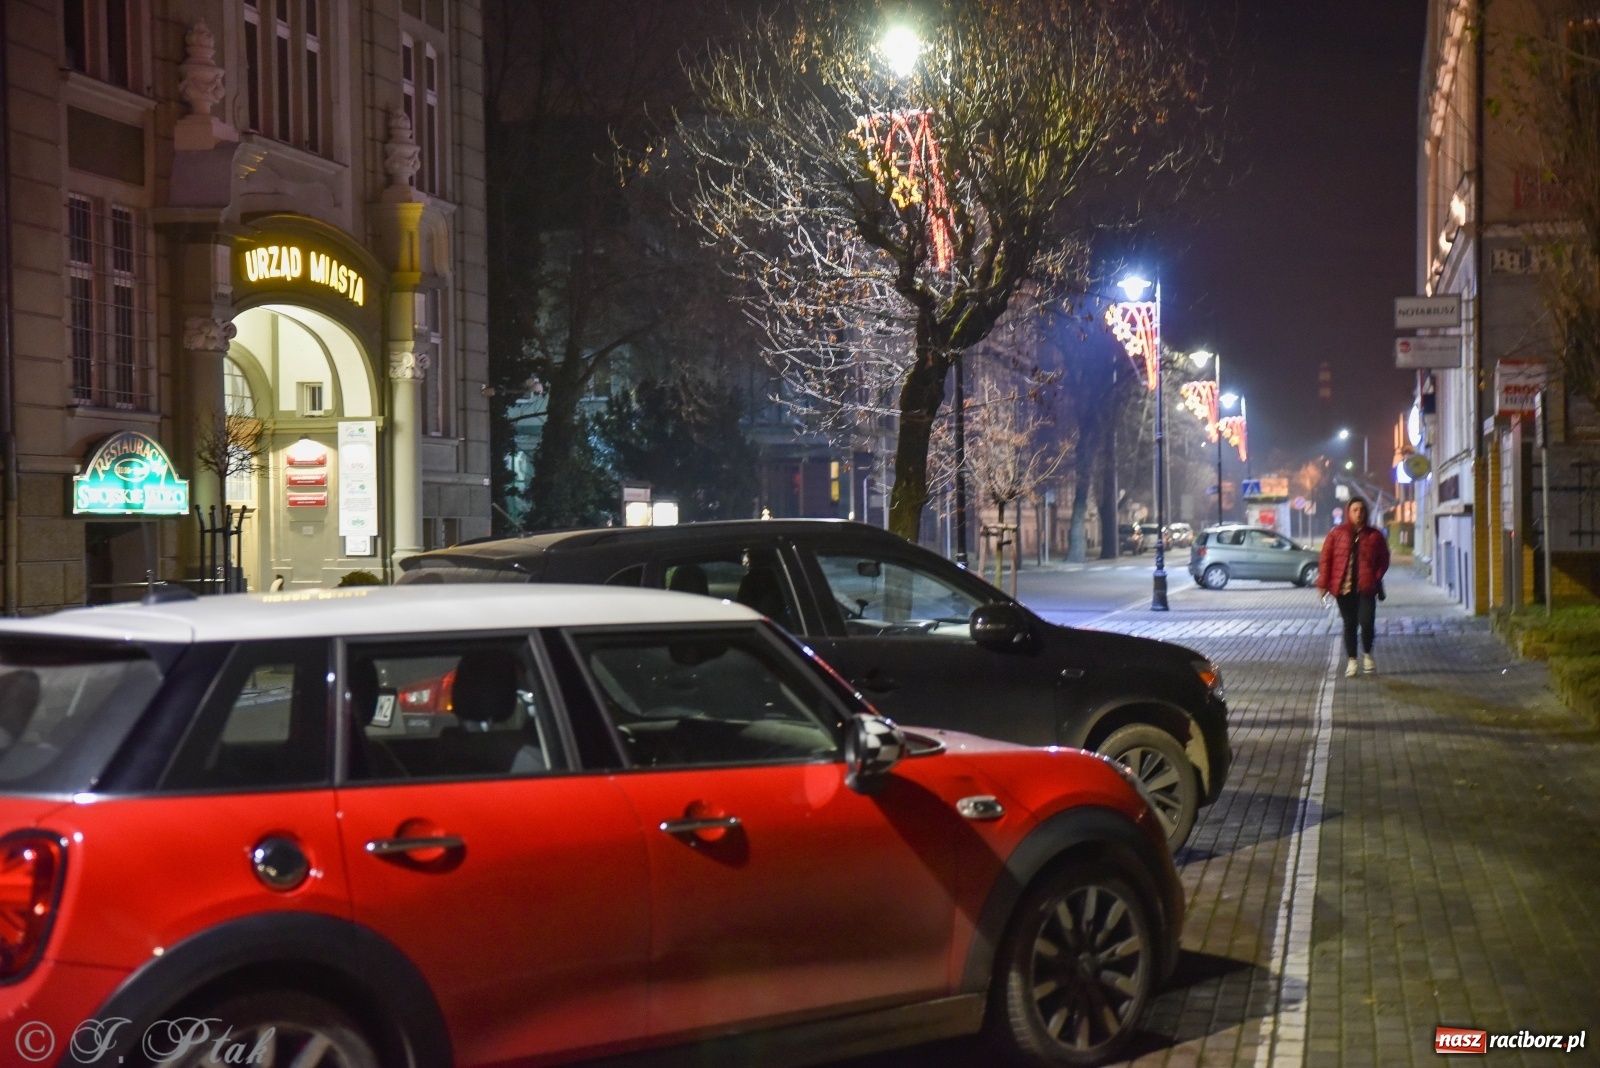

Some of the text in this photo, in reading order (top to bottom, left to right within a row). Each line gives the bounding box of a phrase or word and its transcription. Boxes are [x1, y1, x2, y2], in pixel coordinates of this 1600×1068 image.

[245, 245, 364, 307] URZĄD MIASTA
[1398, 305, 1456, 317] NOTARIUSZ
